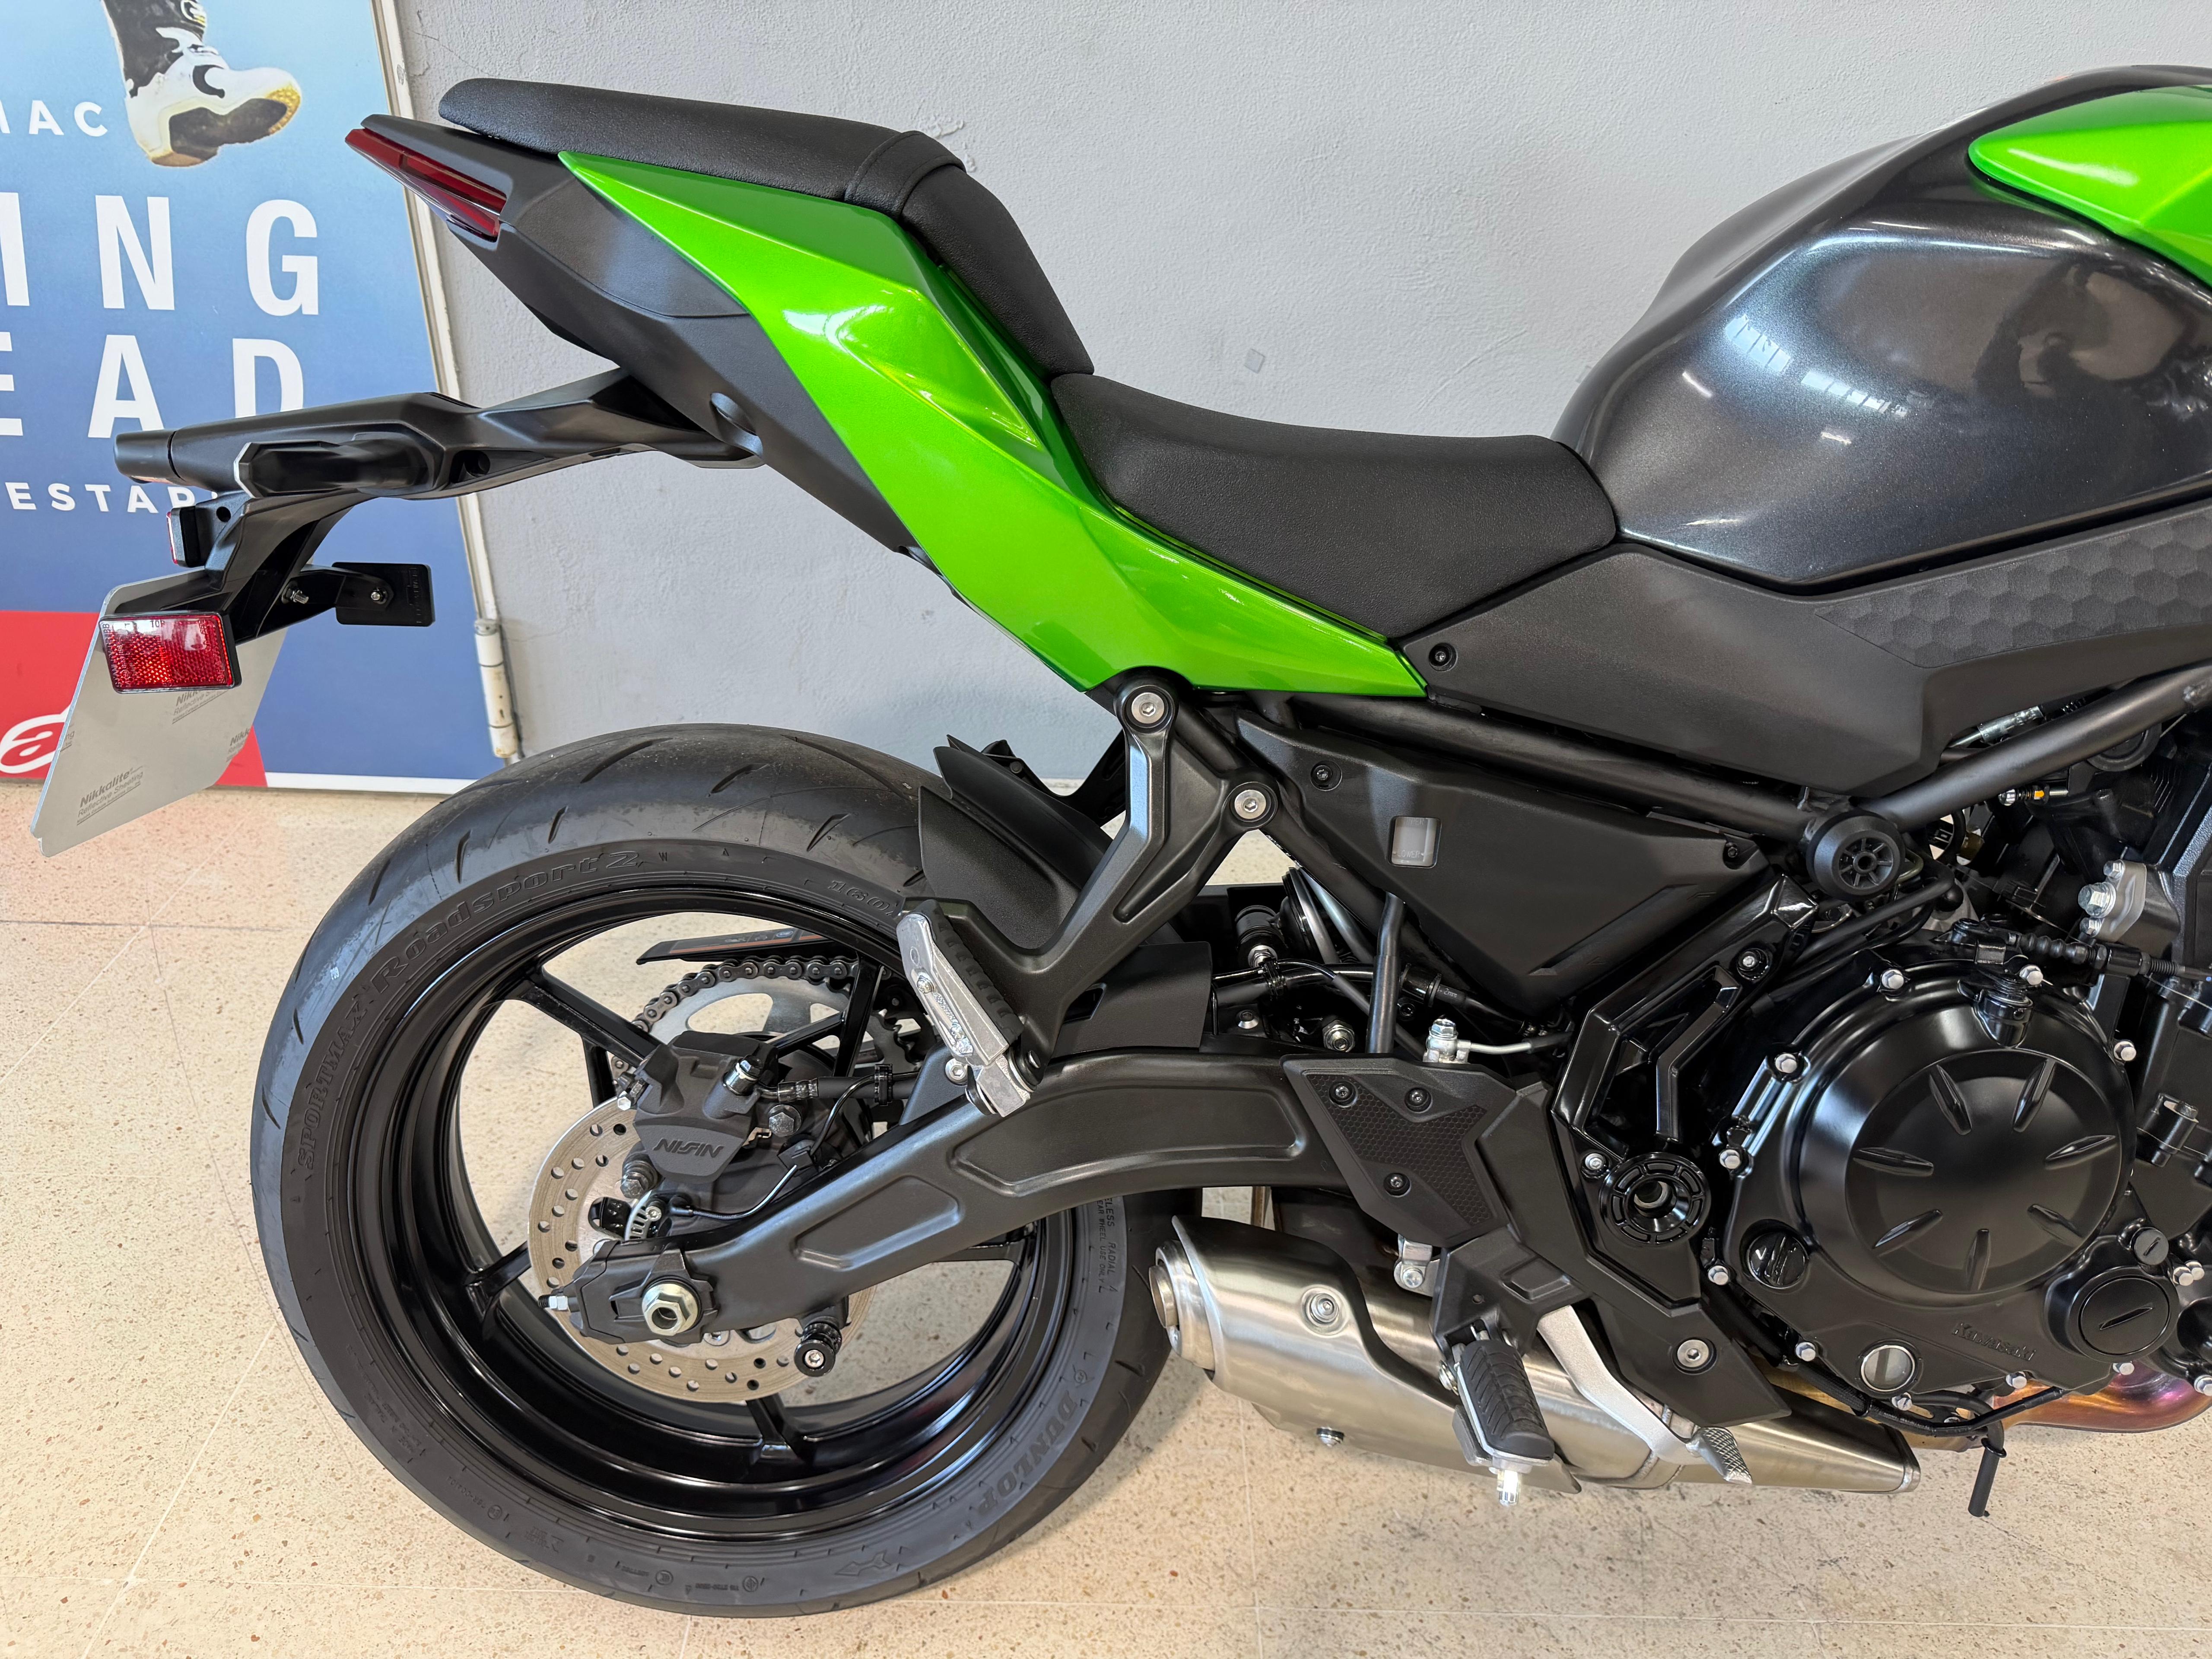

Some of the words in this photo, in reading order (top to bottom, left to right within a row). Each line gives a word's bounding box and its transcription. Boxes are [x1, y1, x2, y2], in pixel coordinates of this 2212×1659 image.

[298, 1000, 368, 1170] SPORTMAX
[652, 1137, 725, 1158] NISSIN
[1098, 1218, 1106, 1242] WHEEL
[1107, 1242, 1116, 1275] RADIAL
[1951, 1322, 2037, 1362] Kawasaki
[977, 1390, 1077, 1515] DUNLOP
